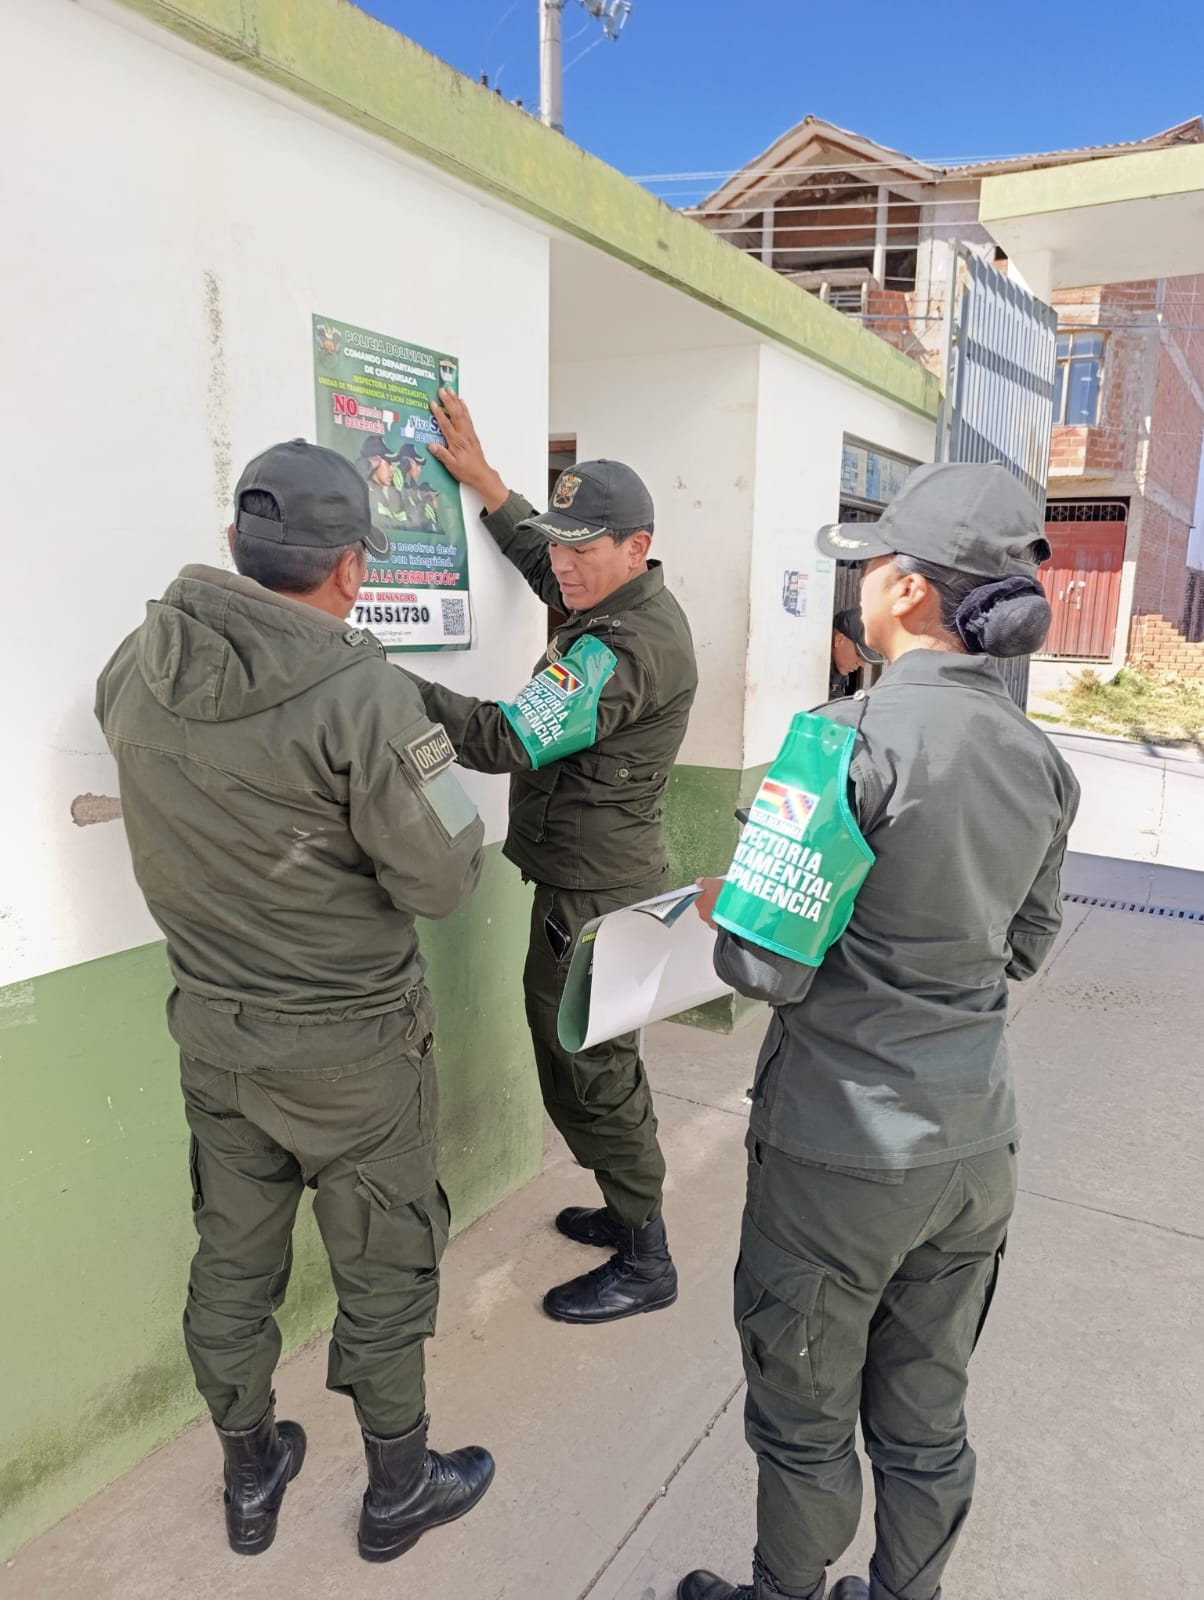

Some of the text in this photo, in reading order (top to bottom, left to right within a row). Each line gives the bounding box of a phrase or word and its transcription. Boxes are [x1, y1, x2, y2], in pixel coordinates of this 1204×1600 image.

[344, 347, 436, 380] COMANDO DEPARTAMENTAL
[386, 342, 435, 368] BOLIVIANA
[364, 365, 417, 386] DE CHUQUISACA
[333, 393, 358, 417] NO
[391, 555, 408, 564] con
[398, 543, 435, 554] nosotros
[370, 568, 380, 583] A
[380, 568, 394, 583] LA
[356, 605, 430, 623] 71551730
[528, 679, 569, 722] PECTORIA
[516, 698, 553, 747] ARENCIA
[741, 822, 823, 874] PECTORIA
[733, 842, 833, 903] TAMENTAL
